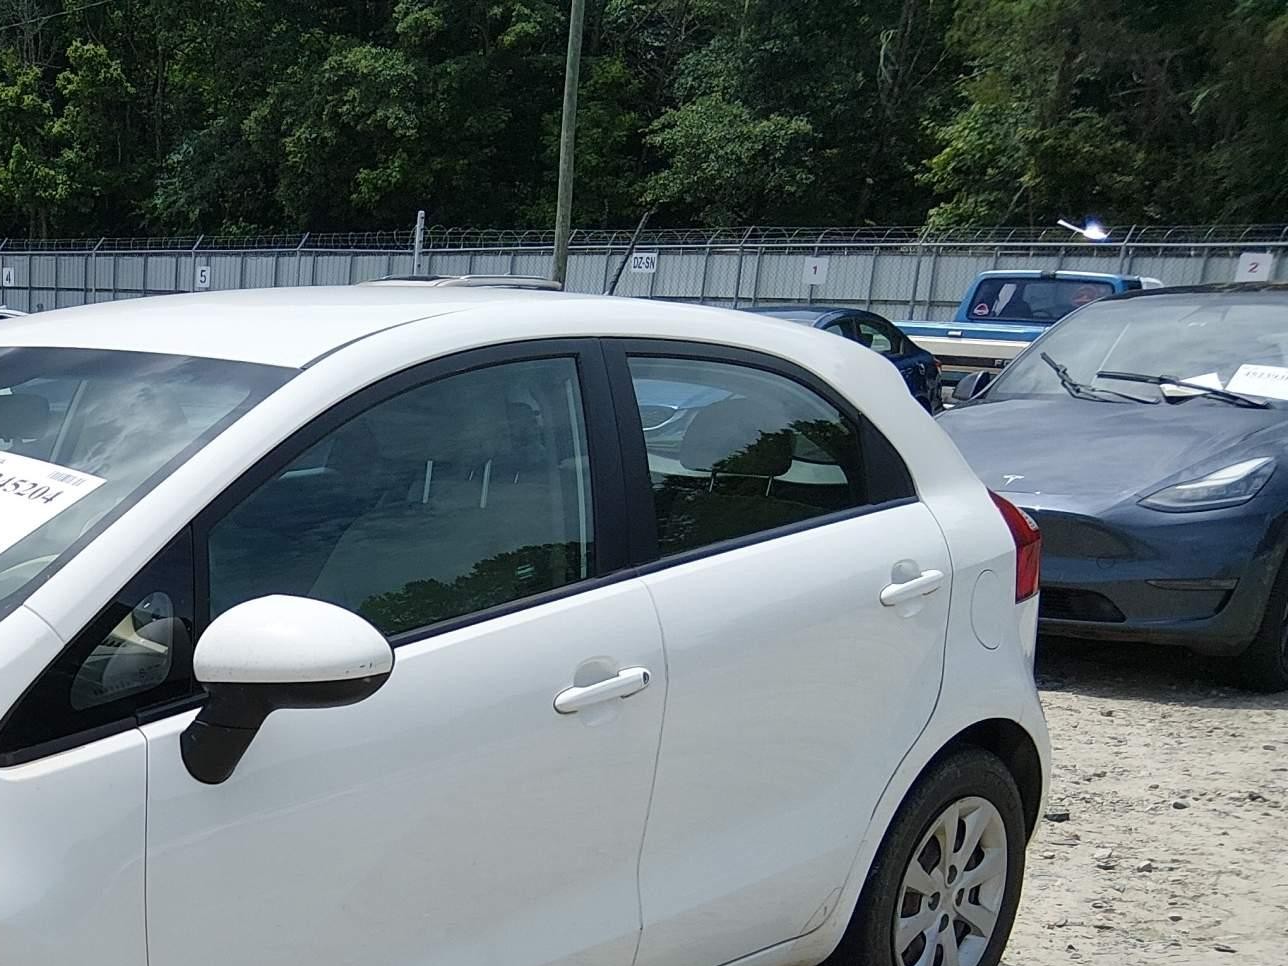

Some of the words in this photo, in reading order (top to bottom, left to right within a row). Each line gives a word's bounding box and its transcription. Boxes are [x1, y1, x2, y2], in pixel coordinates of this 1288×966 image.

[632, 256, 656, 269] DZ-SN
[1248, 262, 1258, 273] 2
[5, 271, 11, 284] 4
[199, 269, 207, 284] 5
